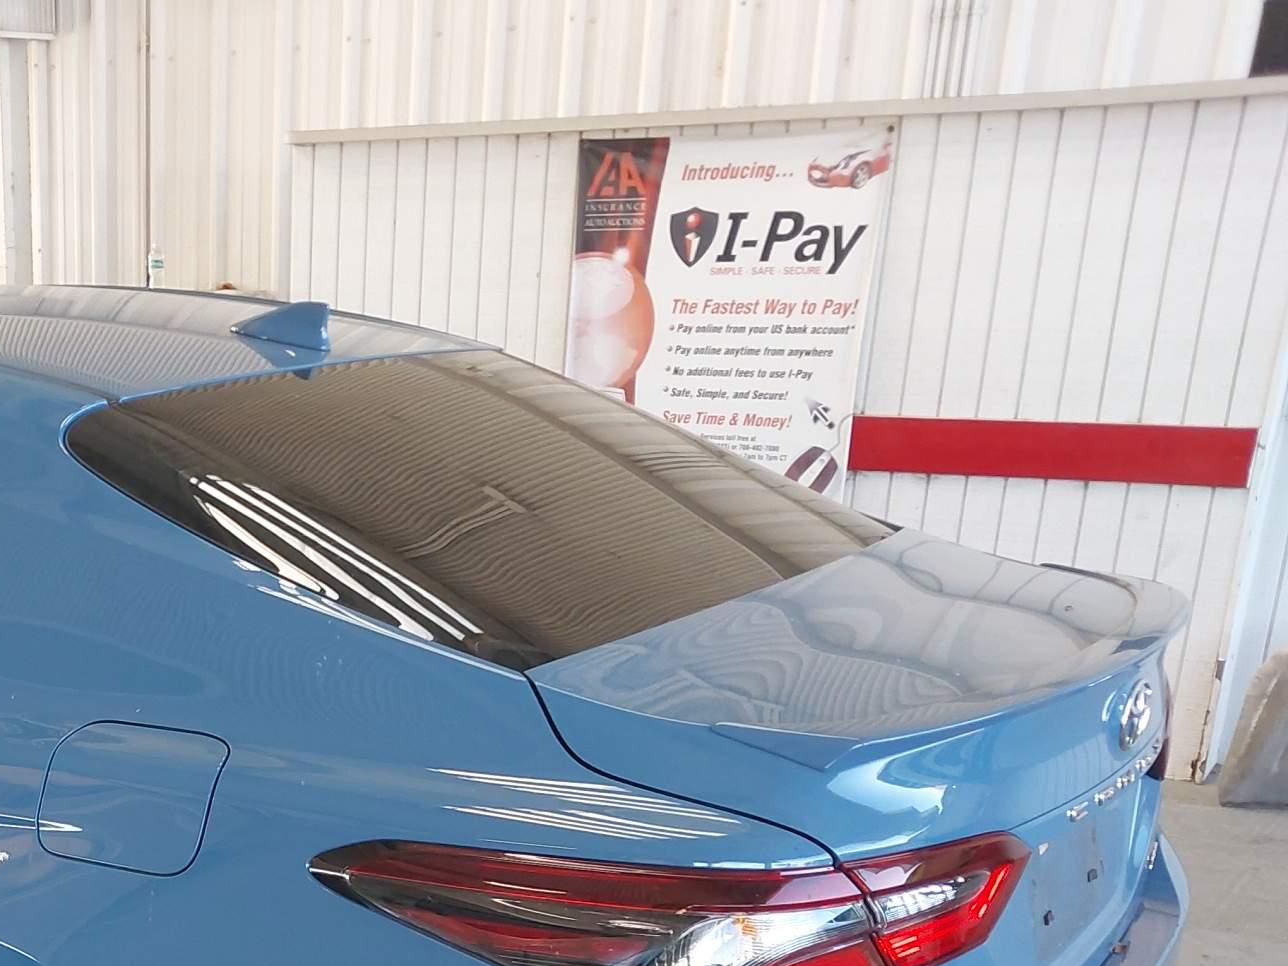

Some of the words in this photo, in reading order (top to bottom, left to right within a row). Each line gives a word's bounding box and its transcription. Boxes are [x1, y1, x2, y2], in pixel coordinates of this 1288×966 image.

[681, 162, 794, 182] Introducing...
[715, 211, 868, 274] I-Pay
[711, 266, 744, 276] SIMPLE
[751, 266, 776, 276] SAFE
[783, 266, 823, 276] SECURE
[672, 299, 697, 315] The
[702, 299, 759, 315] Fastest
[764, 299, 796, 318] Way
[801, 300, 817, 315] to
[821, 299, 860, 319] Pay!
[677, 323, 692, 336] Pay
[695, 324, 723, 334] online
[725, 324, 746, 334] from
[748, 326, 769, 336] your
[771, 324, 783, 334] US
[785, 325, 807, 335] bank
[675, 345, 691, 356] Pay
[693, 346, 722, 356] online
[724, 347, 761, 358] anytime
[763, 347, 785, 357] from
[787, 348, 834, 359] anywhere
[672, 367, 684, 376] No
[686, 367, 733, 377] additional
[735, 368, 754, 378] fees
[757, 369, 767, 378] to
[769, 370, 786, 379] use
[788, 369, 814, 381] I-Pay
[670, 387, 693, 399] Safe,
[696, 388, 730, 401] Simple,
[732, 390, 750, 400] and
[752, 390, 789, 401] Secure!
[663, 410, 692, 424] Save
[696, 411, 725, 426] Time
[729, 412, 739, 426] &
[743, 413, 792, 431] Money!
